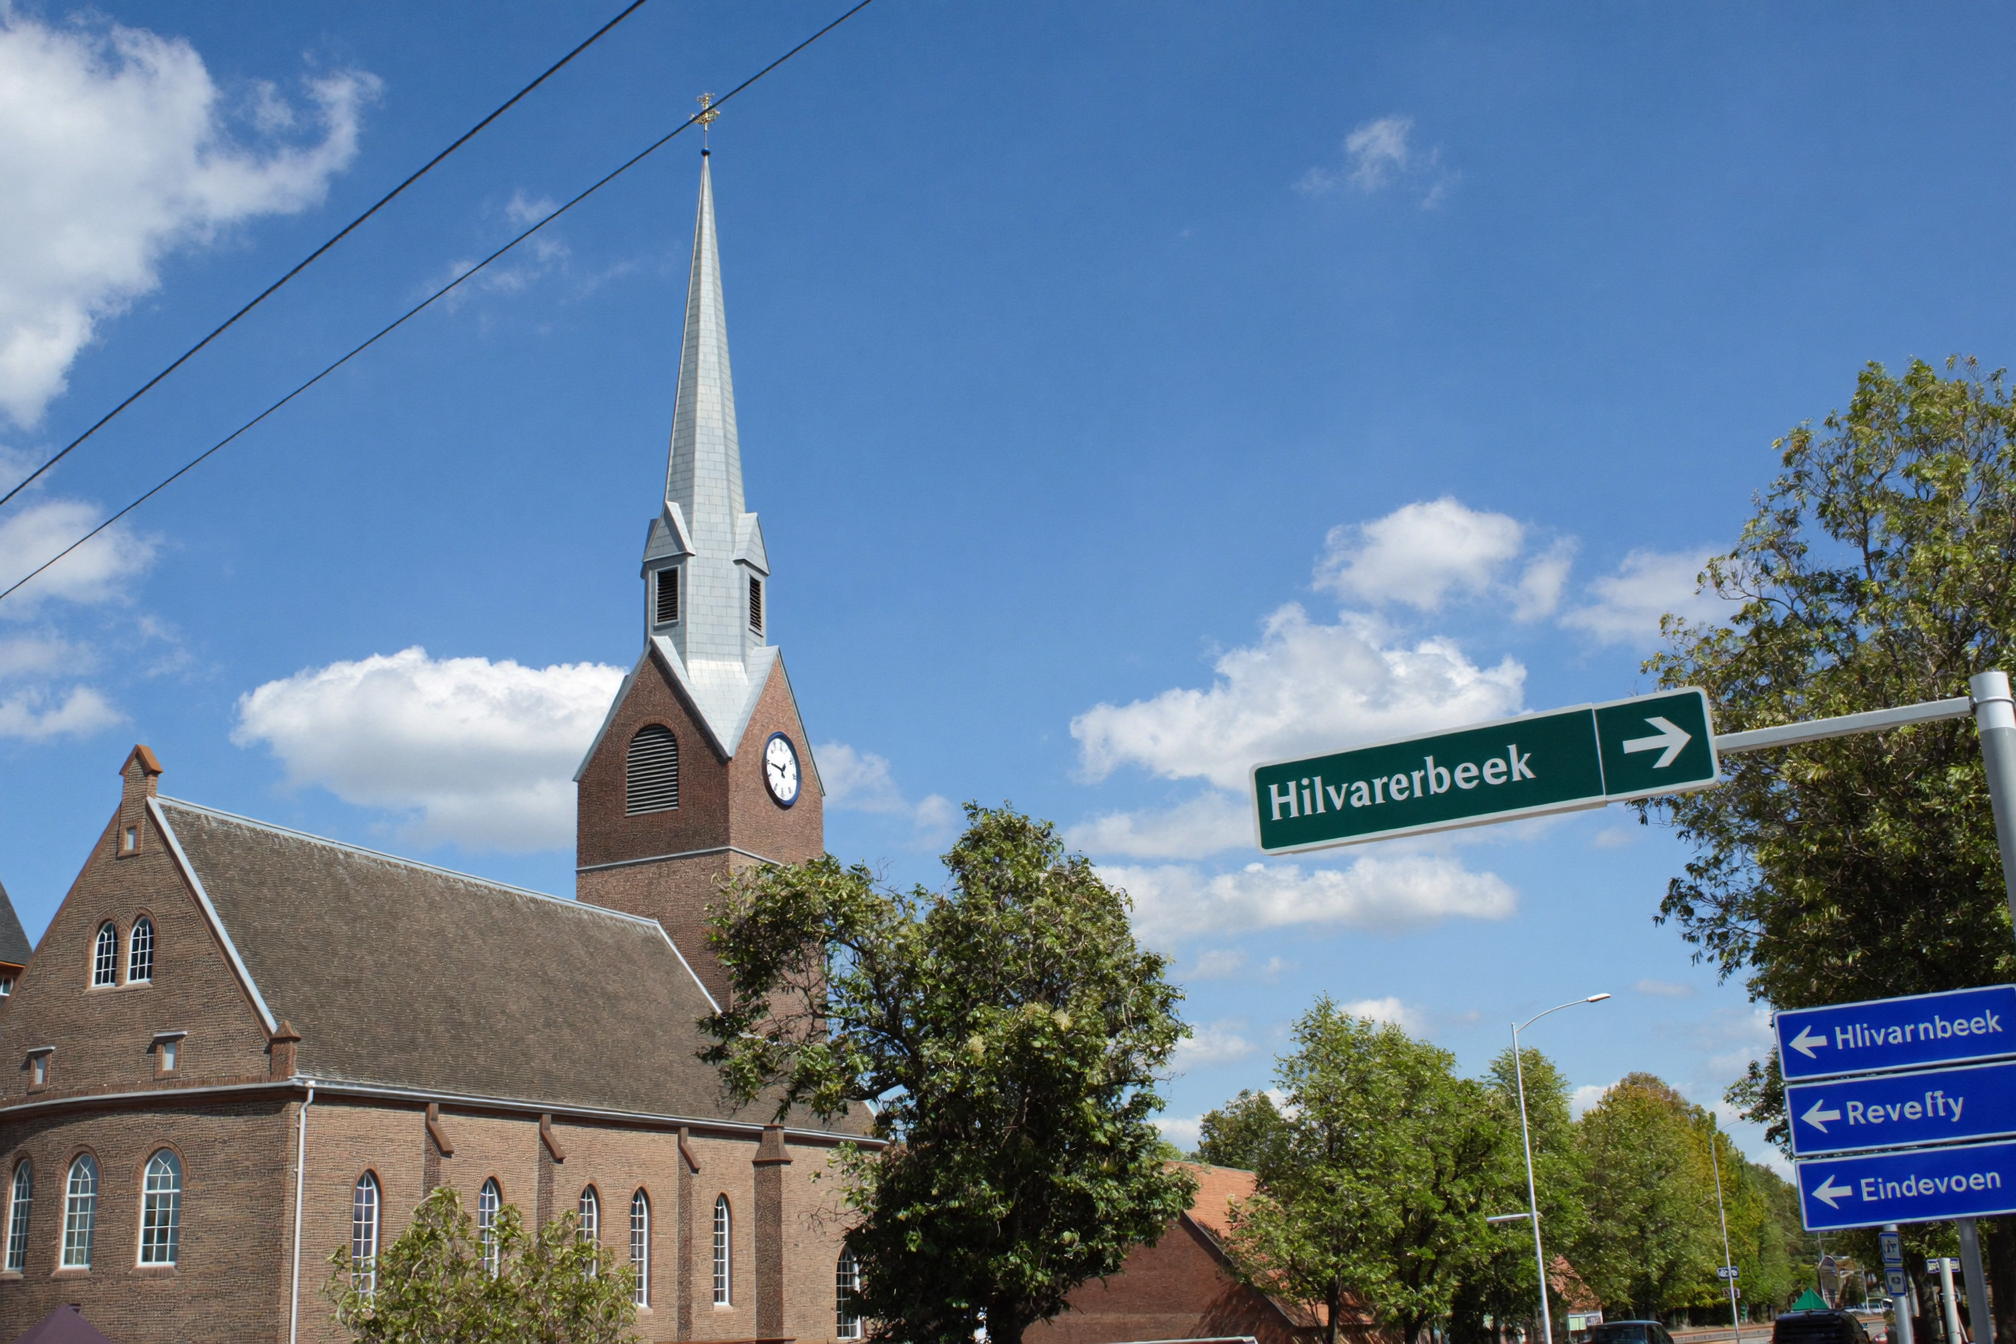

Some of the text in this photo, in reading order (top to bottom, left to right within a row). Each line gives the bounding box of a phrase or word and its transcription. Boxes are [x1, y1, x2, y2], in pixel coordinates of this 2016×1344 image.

[1268, 744, 1537, 820] Hilvarerbeek
[1835, 1009, 2003, 1049] Hlivarnbeek
[1860, 1171, 2001, 1201] Eindevoen
